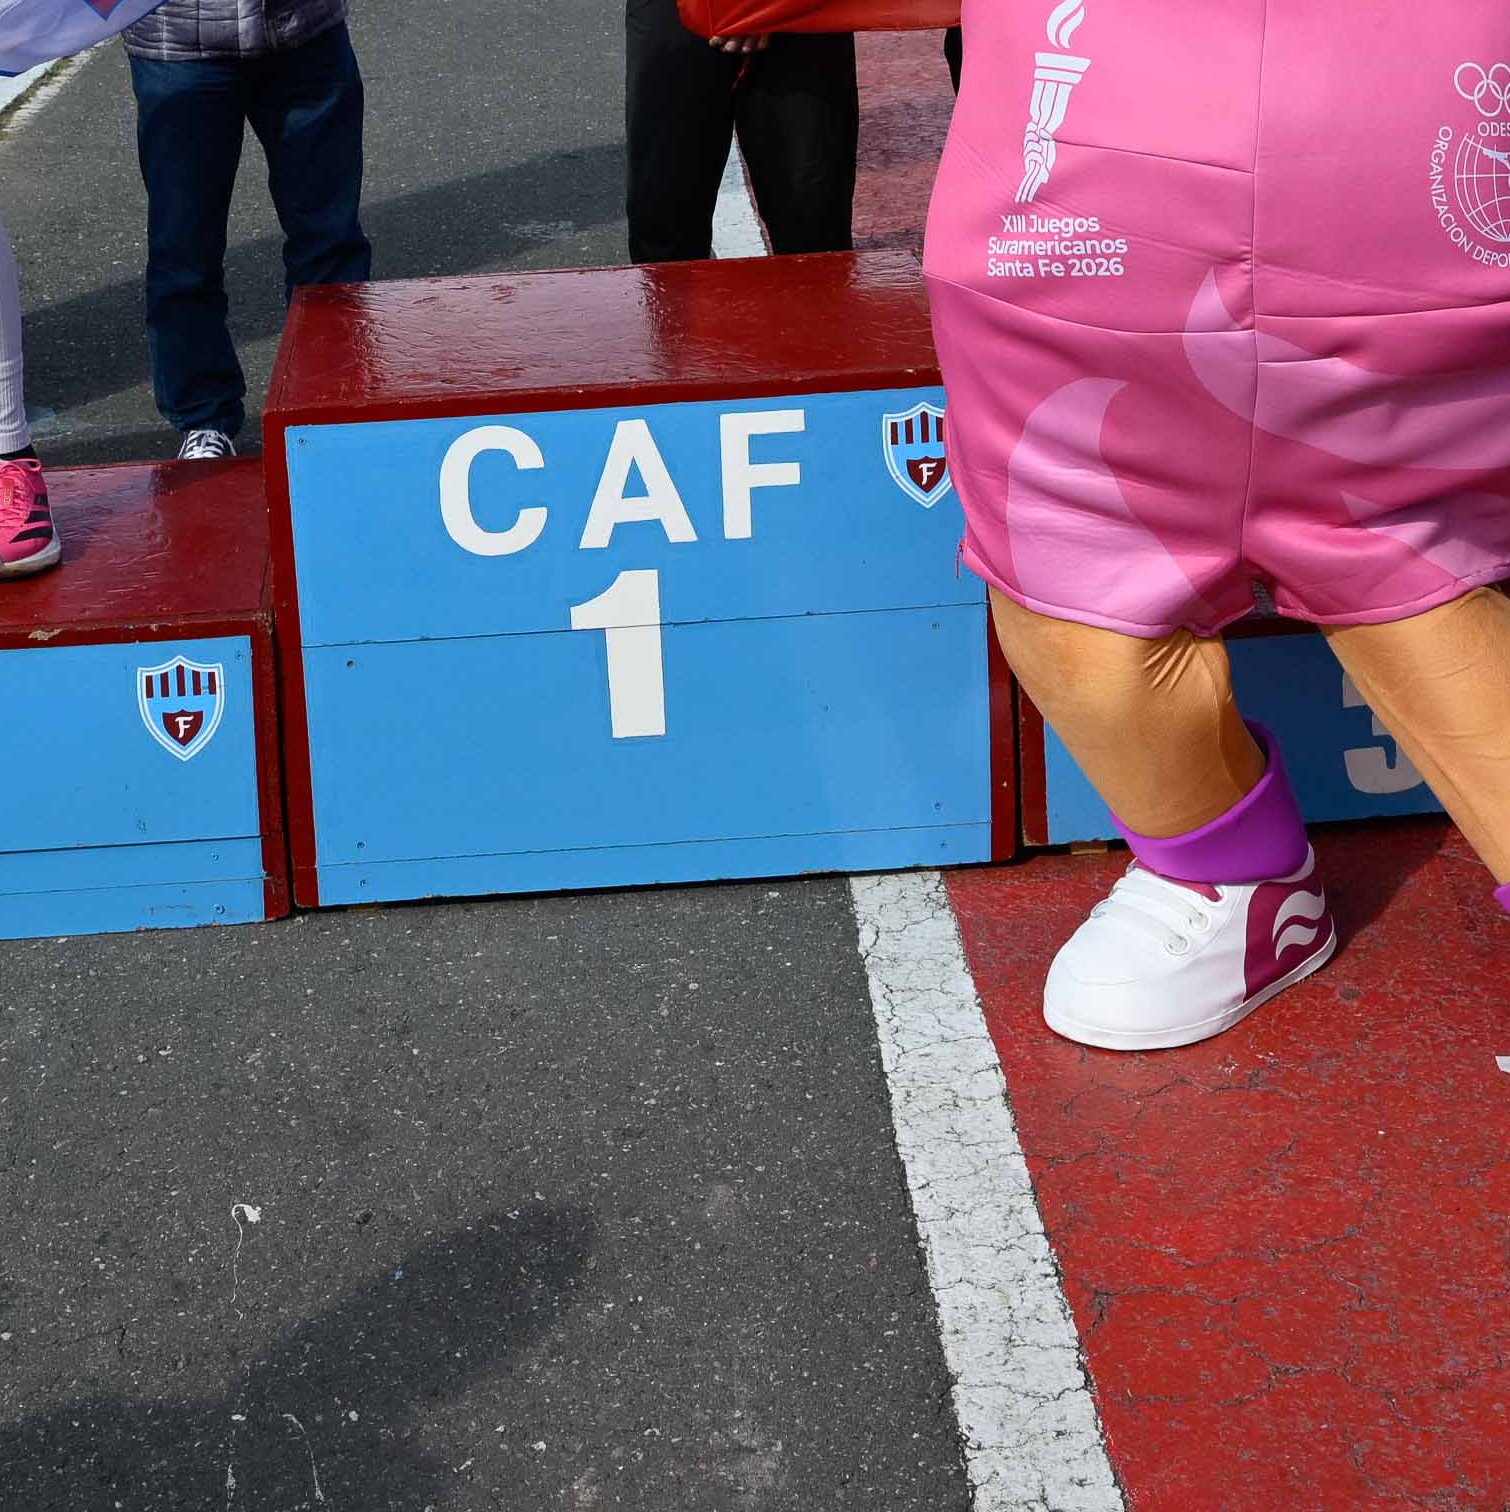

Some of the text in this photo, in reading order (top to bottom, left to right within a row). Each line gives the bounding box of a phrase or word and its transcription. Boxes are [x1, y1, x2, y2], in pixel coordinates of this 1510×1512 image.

[1001, 215, 1100, 237] XIII Juegos
[1429, 126, 1473, 253] ORGANIZACION
[987, 236, 1128, 255] Suramericanos
[987, 257, 1124, 277] Santa Fe 2026
[440, 410, 804, 555] CAF
[571, 569, 666, 739] 1
